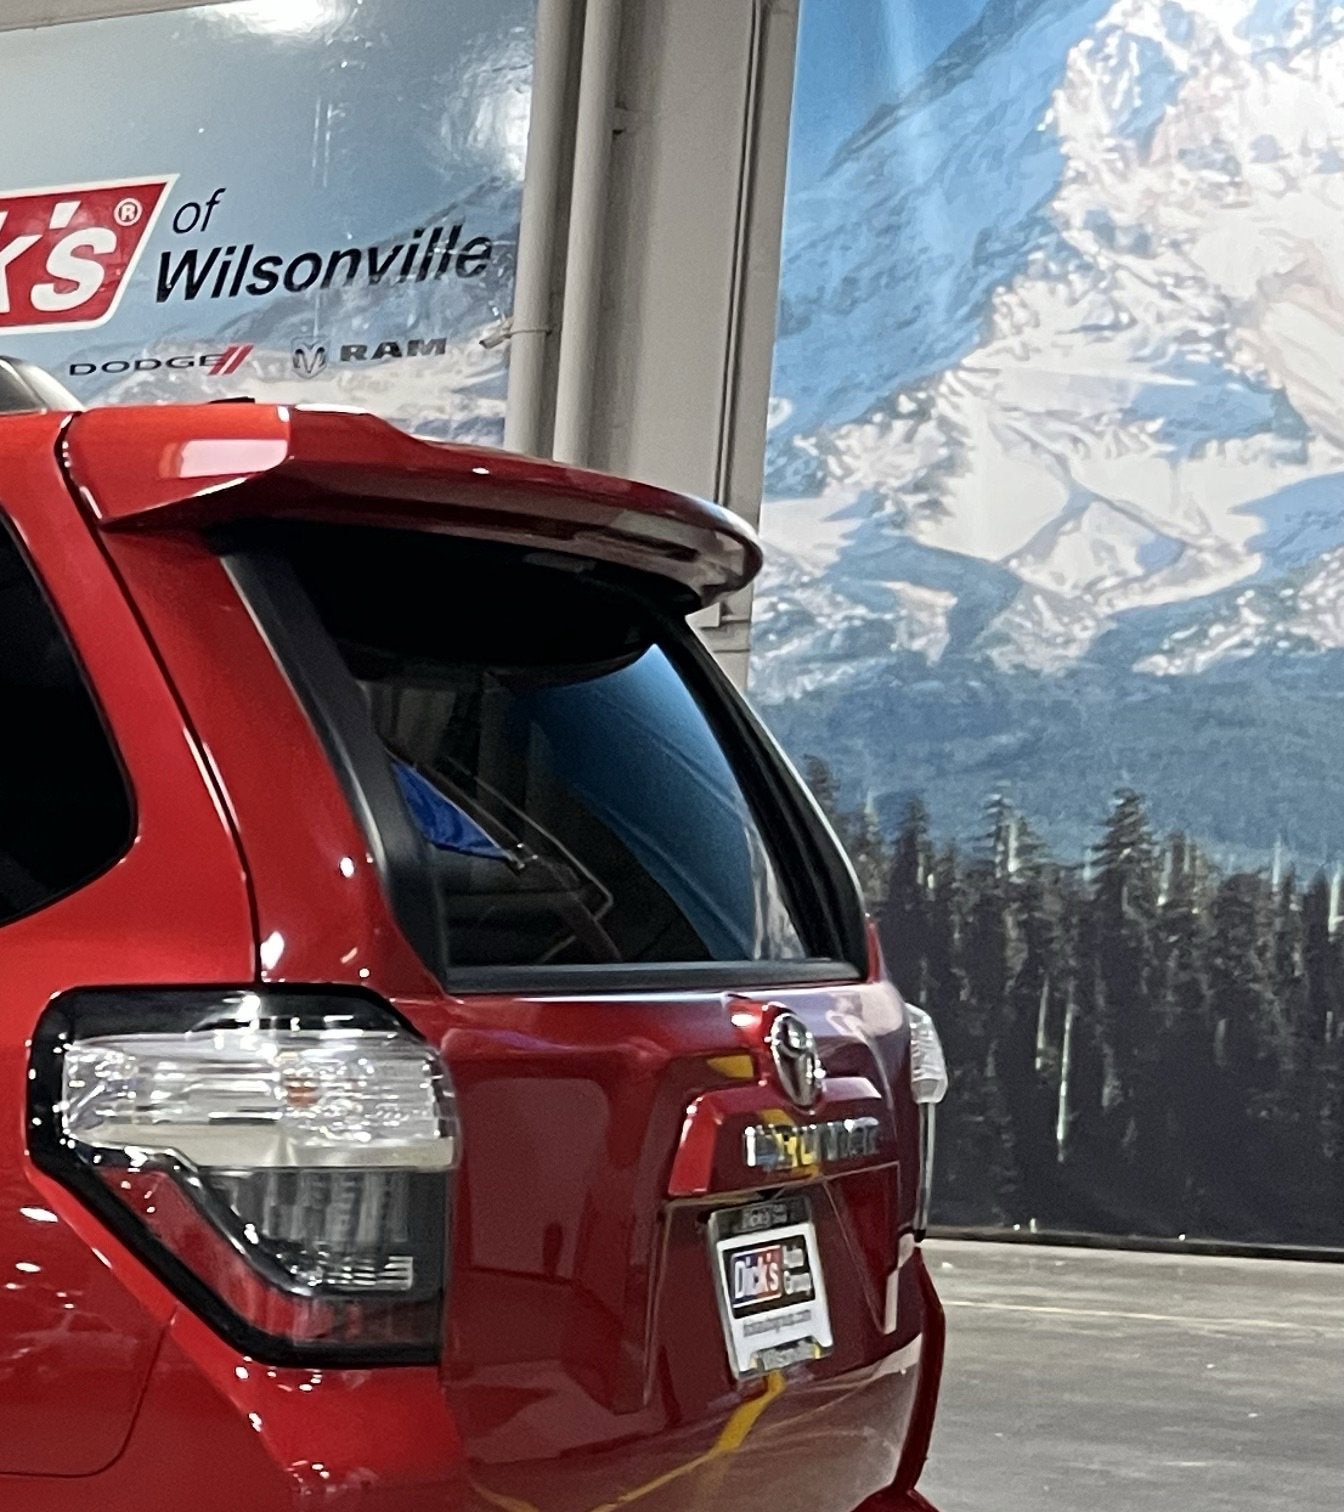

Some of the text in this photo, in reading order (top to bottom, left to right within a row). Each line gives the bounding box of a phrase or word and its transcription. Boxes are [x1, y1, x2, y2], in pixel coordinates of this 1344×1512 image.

[171, 188, 227, 234] of
[155, 223, 493, 303] Wilsonville
[69, 353, 223, 376] DODGE
[340, 337, 447, 362] RAM
